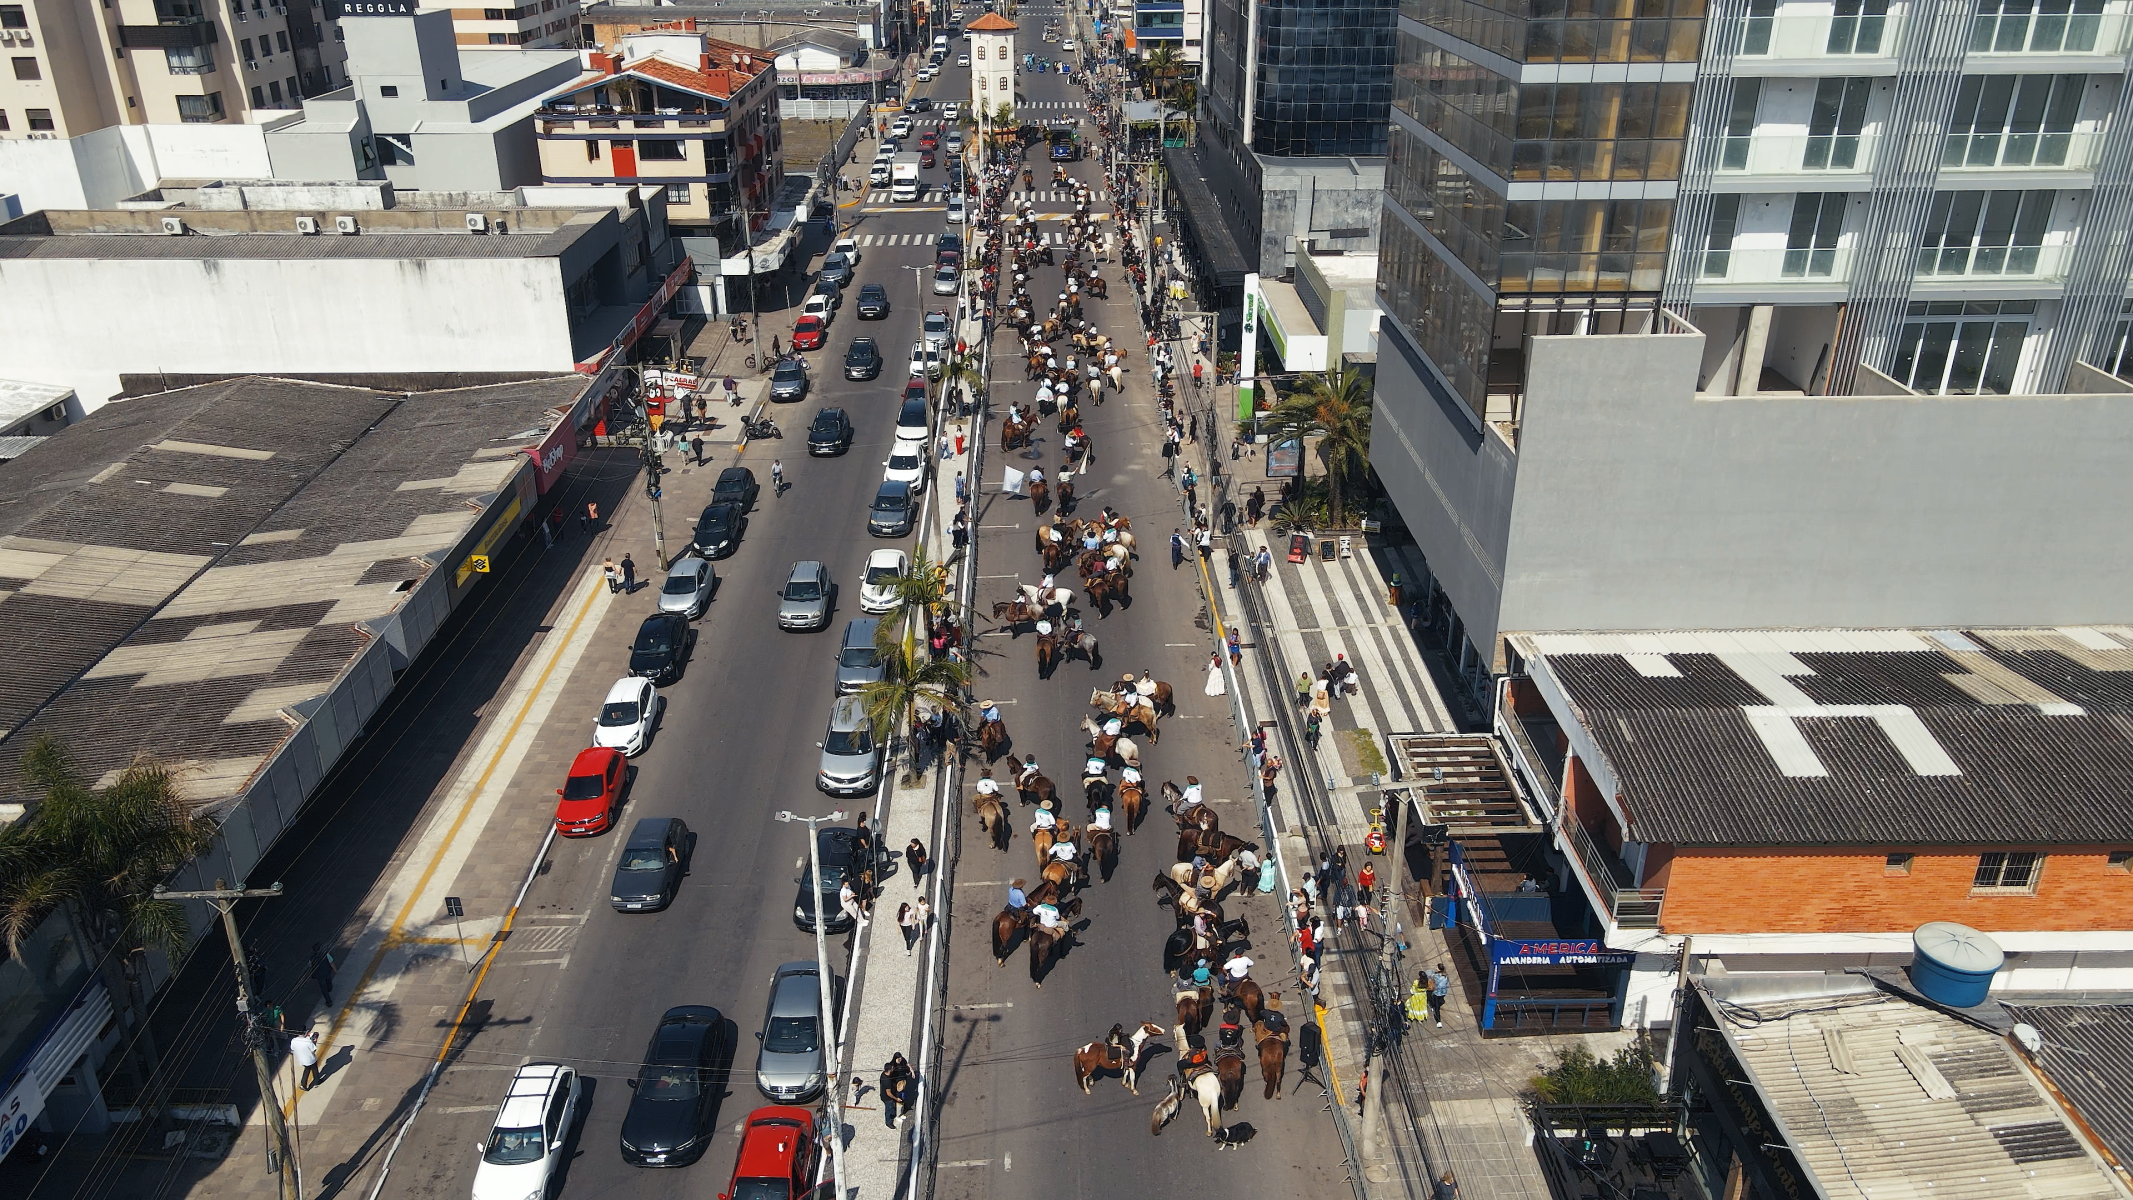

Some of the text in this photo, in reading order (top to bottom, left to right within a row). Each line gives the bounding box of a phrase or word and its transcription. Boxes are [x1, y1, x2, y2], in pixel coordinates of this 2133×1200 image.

[344, 3, 407, 13] REGGLA
[1500, 955, 1628, 965] LAVANDERIA AUTOMATIZADA
